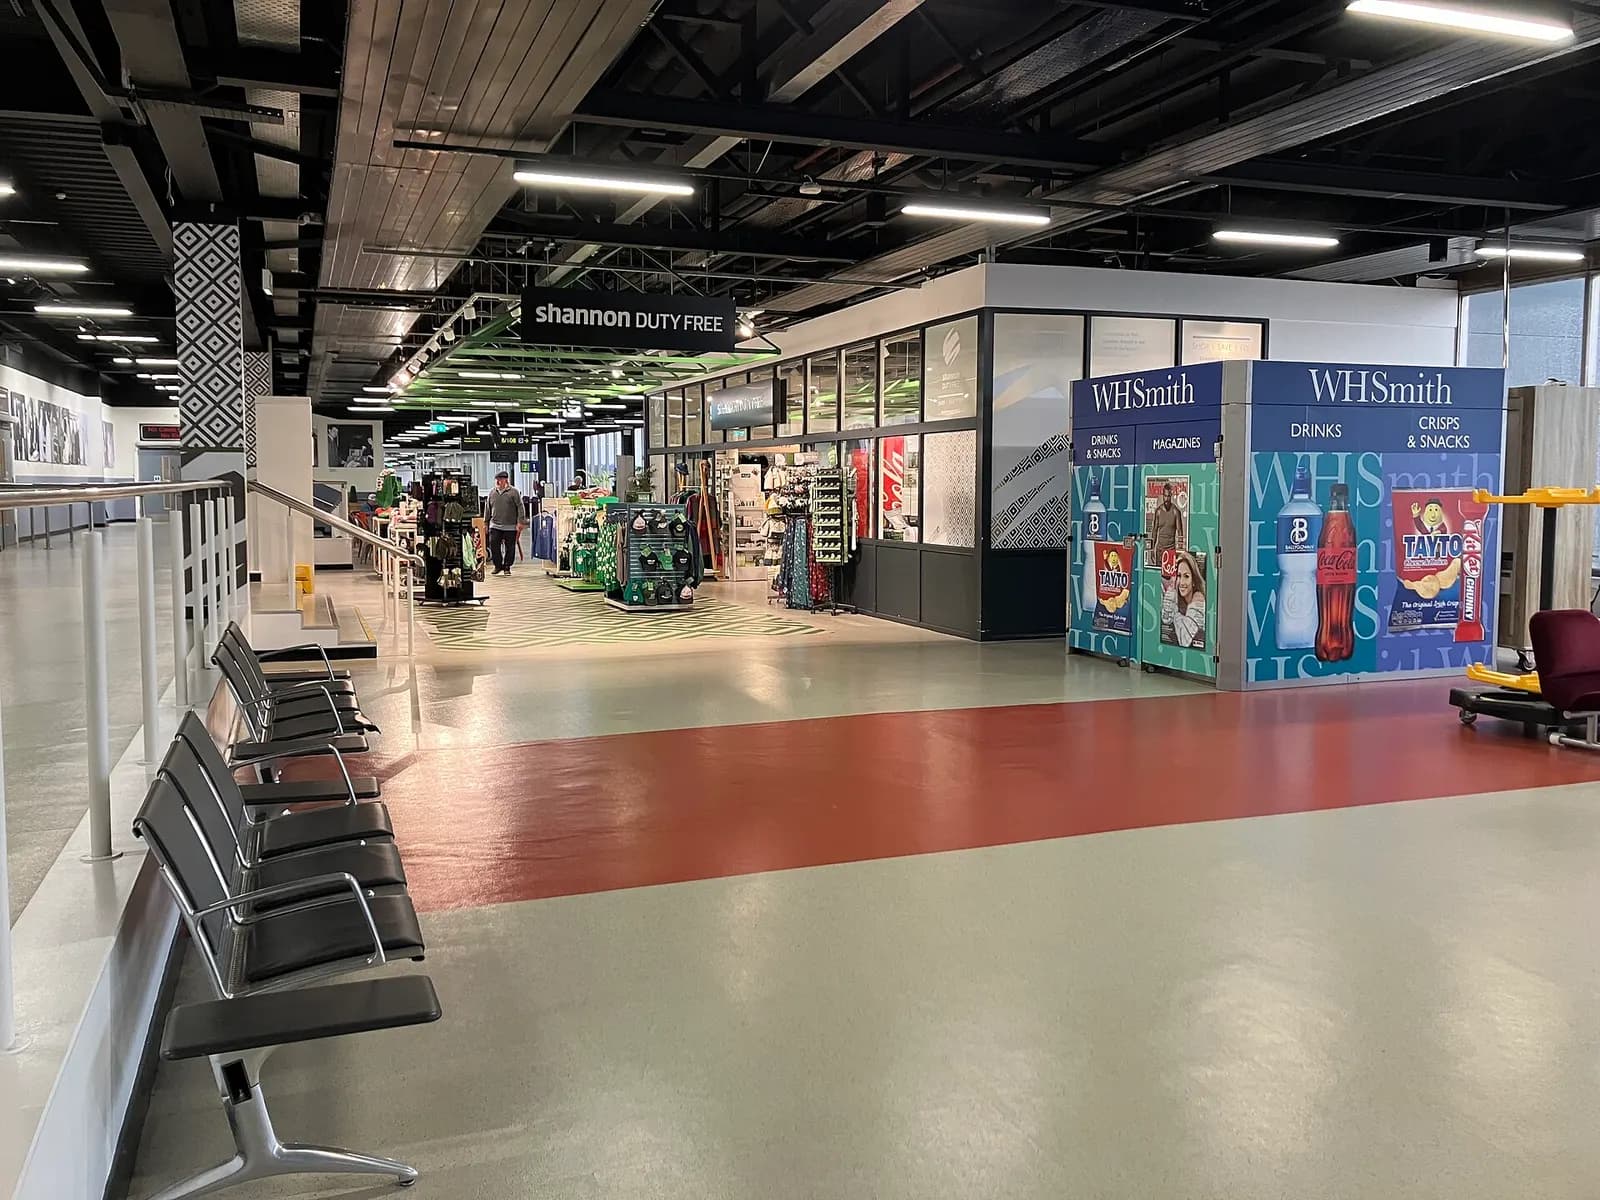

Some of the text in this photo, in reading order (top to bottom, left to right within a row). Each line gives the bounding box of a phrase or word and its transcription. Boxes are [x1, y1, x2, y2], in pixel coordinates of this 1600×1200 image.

[535, 303, 723, 332] shannon DUTY FREE
[1092, 373, 1195, 412] WHSmith
[1309, 368, 1452, 405] WHSmith
[1291, 423, 1342, 438] DRINKS
[1418, 416, 1460, 430] CRISPS
[1091, 435, 1118, 446] DRINKS
[1153, 437, 1201, 450] MAGAZINES
[1407, 435, 1470, 449] & SNACKS
[1086, 448, 1121, 459] & SNACKS
[1403, 535, 1464, 559] TAYTO
[1100, 571, 1128, 588] TAYTO
[1465, 578, 1475, 620] CHUNKY
